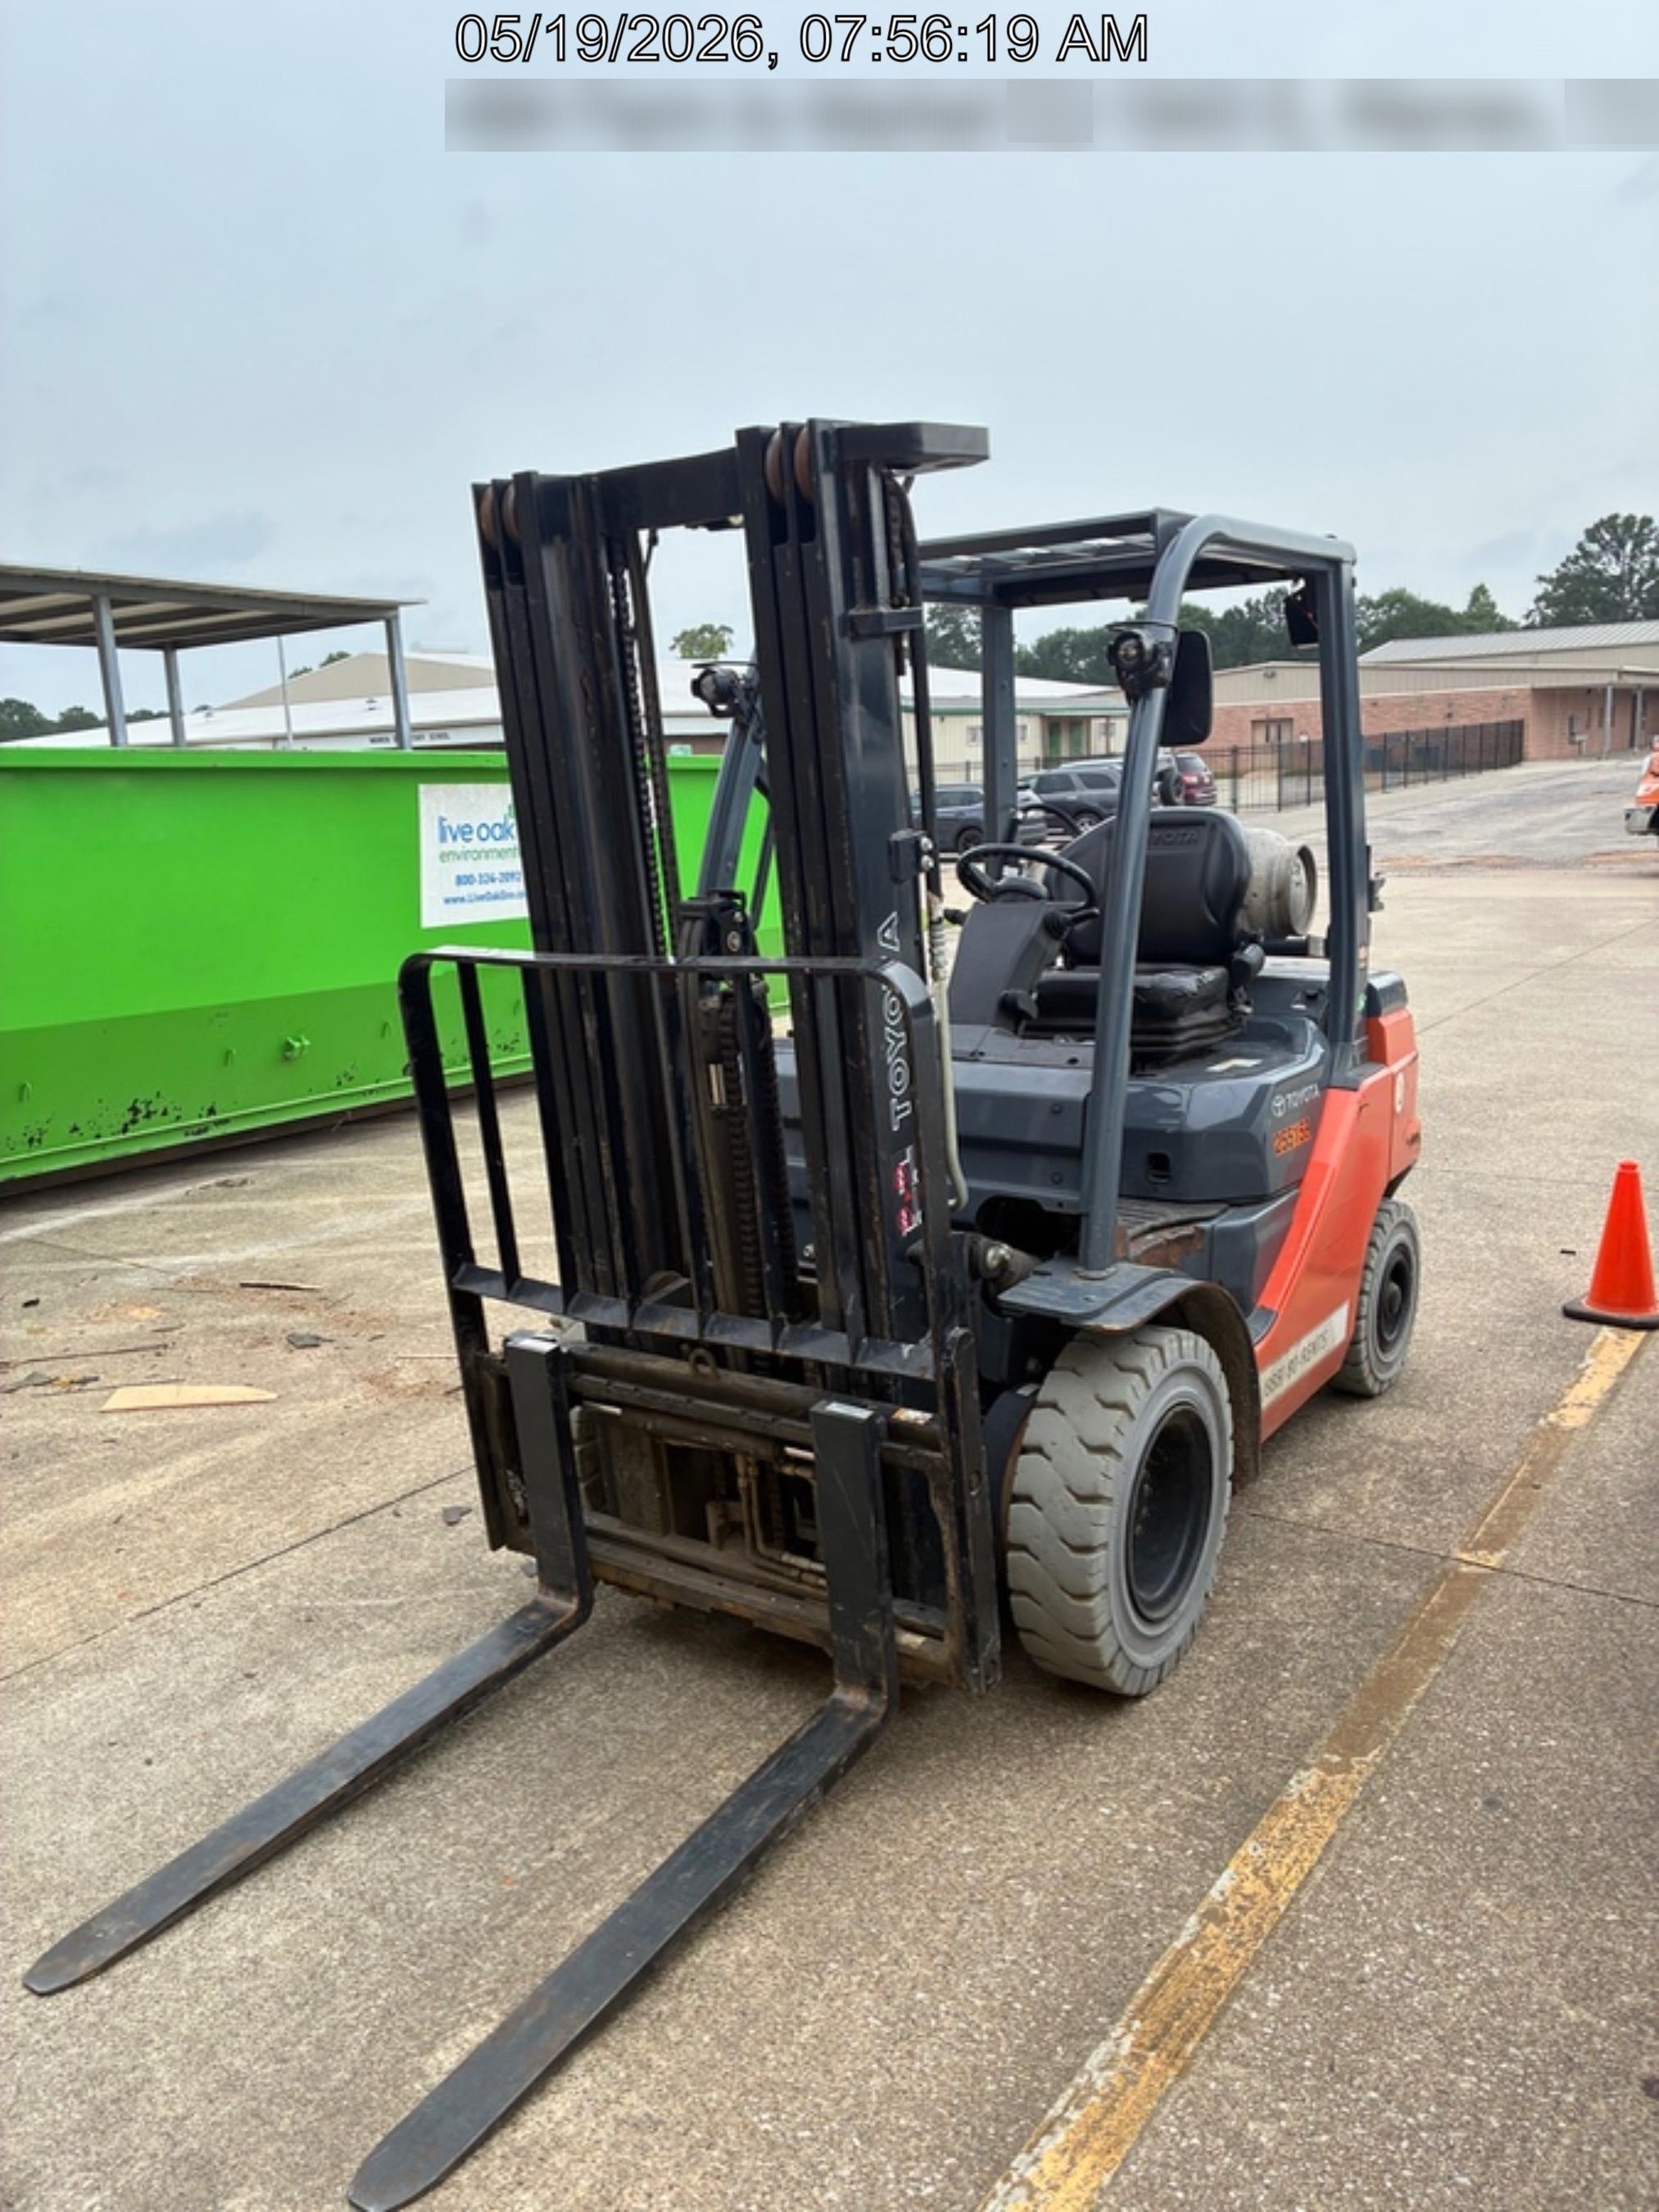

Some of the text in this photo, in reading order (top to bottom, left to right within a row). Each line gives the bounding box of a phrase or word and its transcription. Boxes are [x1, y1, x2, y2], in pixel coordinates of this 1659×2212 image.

[437, 814, 514, 843] live oak
[439, 844, 518, 863] environment
[877, 910, 913, 1132] TOYOA
[1285, 1082, 1321, 1108] TOYOTA
